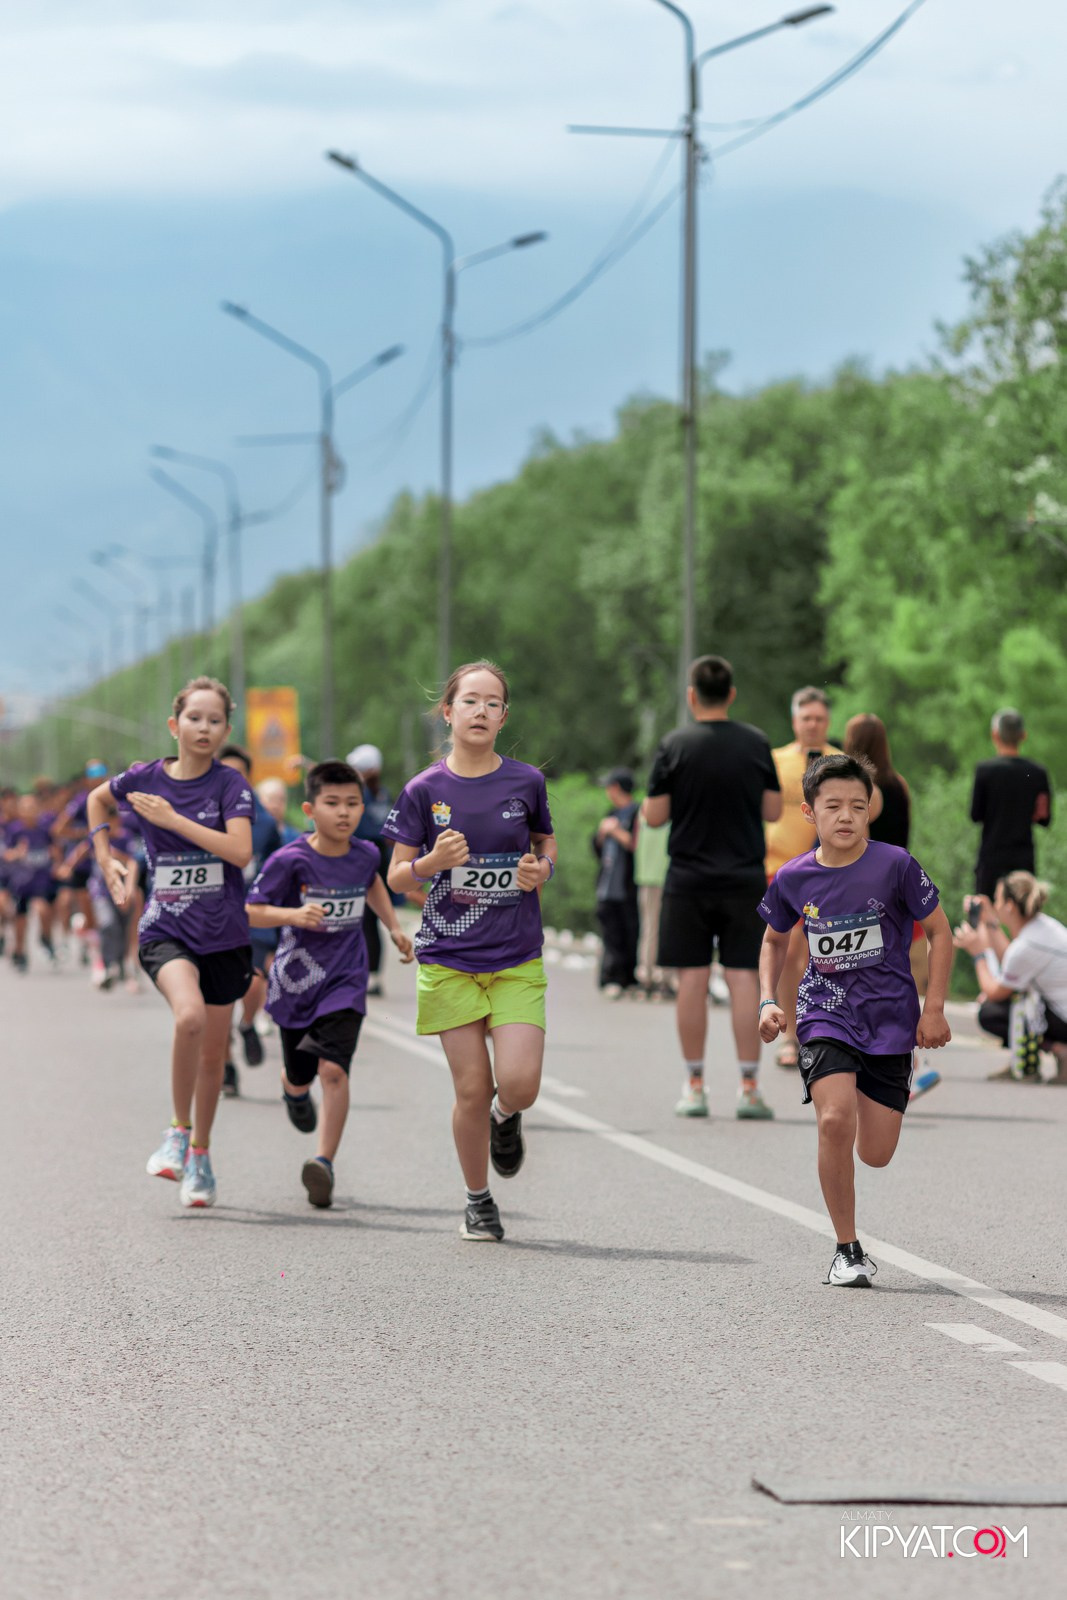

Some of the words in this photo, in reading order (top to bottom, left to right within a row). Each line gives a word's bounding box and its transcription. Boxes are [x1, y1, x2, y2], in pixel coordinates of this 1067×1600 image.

[170, 867, 207, 885] 218
[463, 870, 512, 889] 200
[453, 889, 488, 898] БАЛАЛАР
[818, 929, 868, 955] 047
[845, 949, 881, 961] ЖАРЫСЫ
[834, 962, 850, 971] 600
